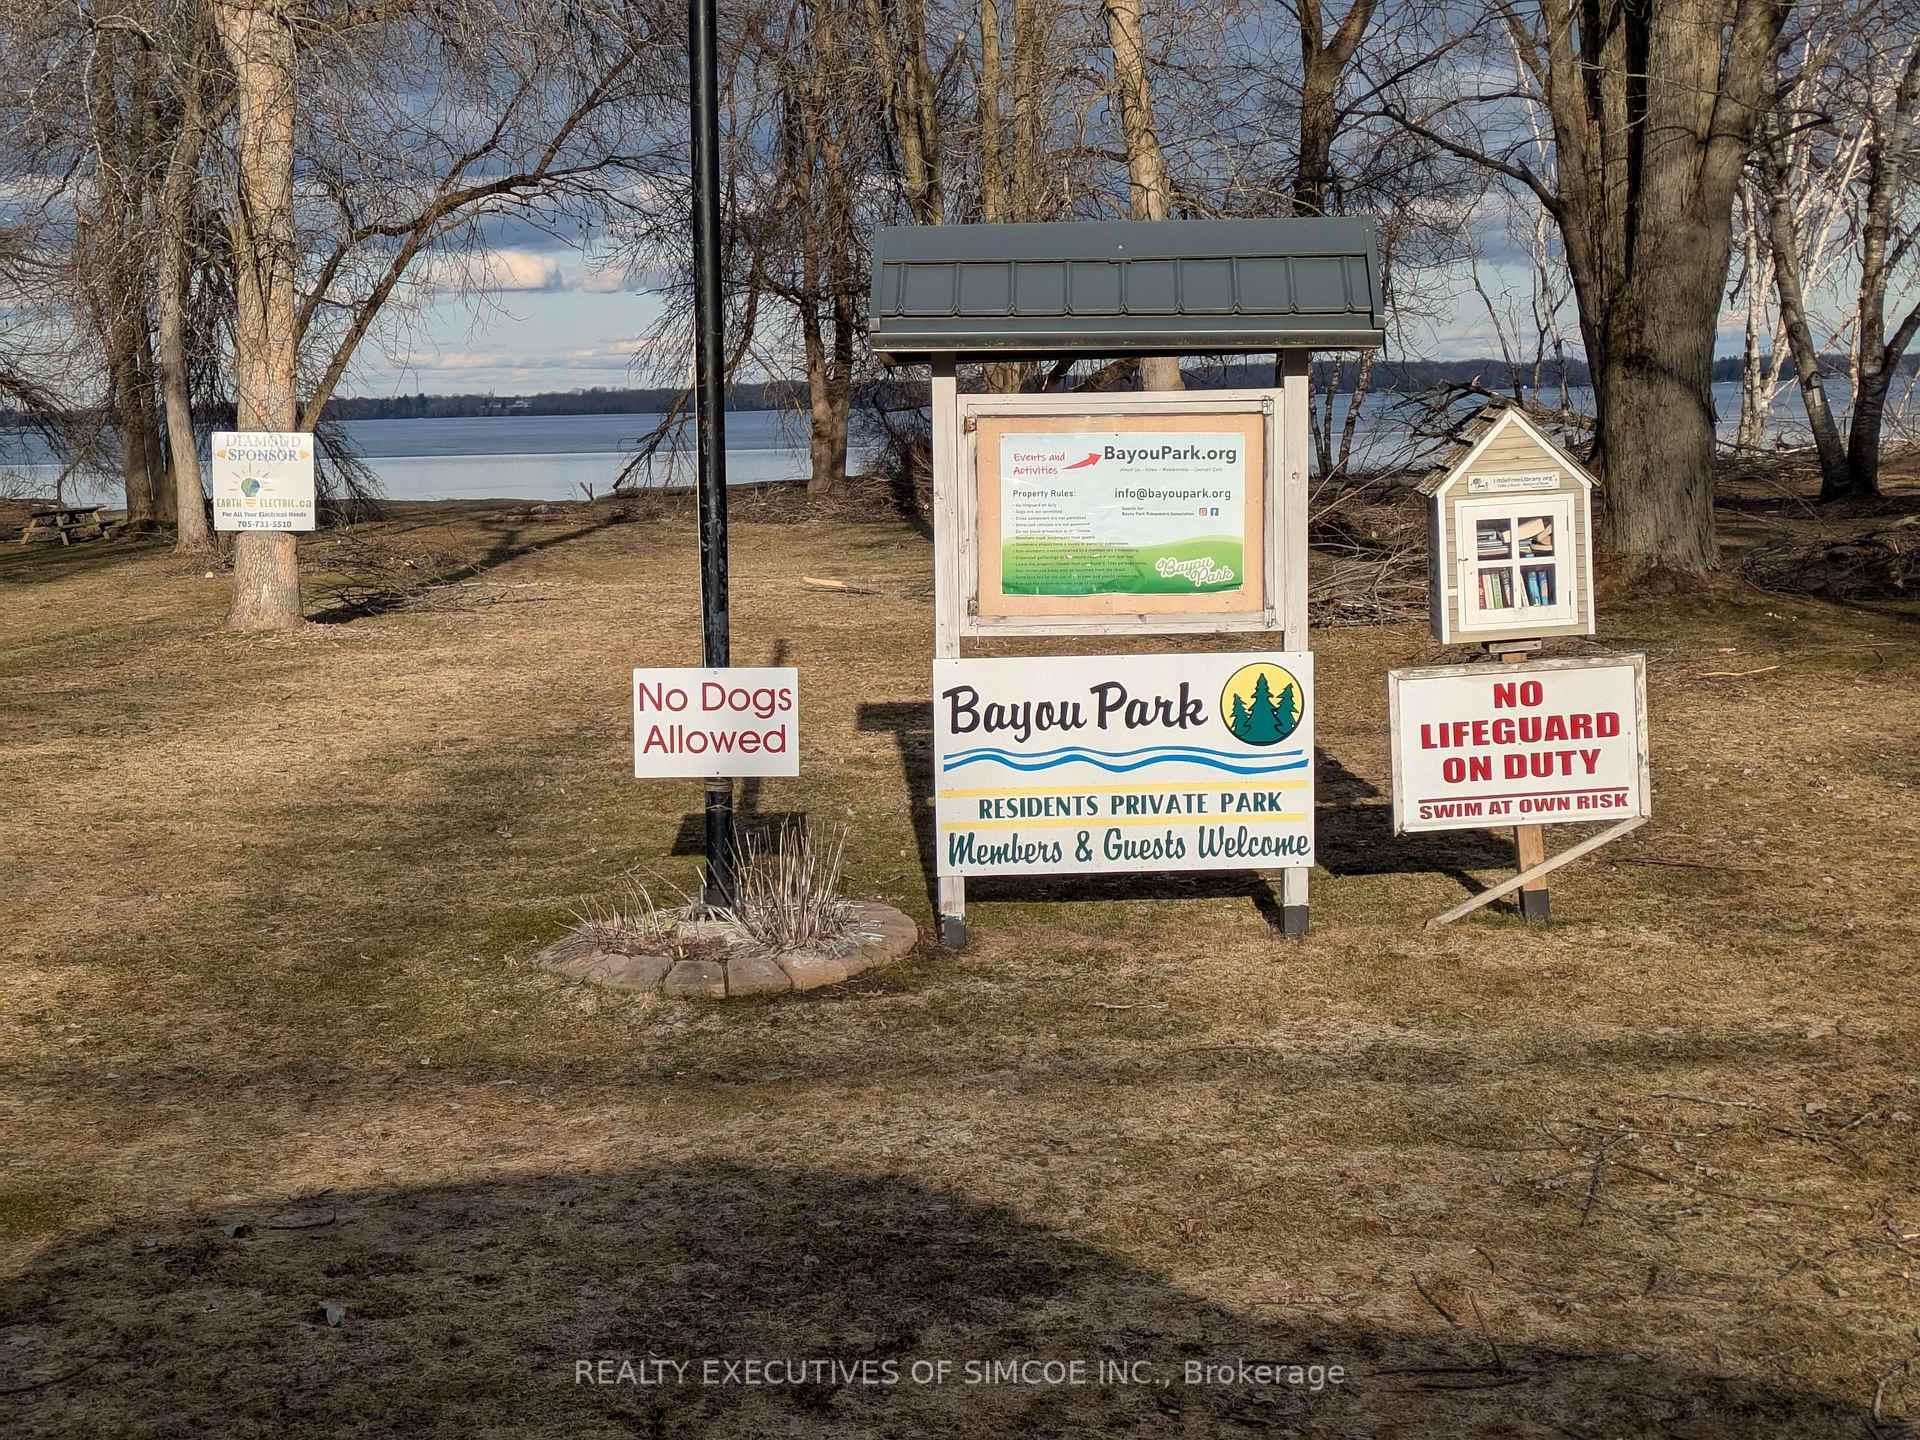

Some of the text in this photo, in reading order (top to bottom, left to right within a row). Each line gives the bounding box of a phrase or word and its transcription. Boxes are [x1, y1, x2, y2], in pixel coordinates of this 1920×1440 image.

[228, 448, 298, 461] SPONSOR
[1013, 452, 1066, 462] Events and
[1104, 445, 1237, 464] BayouPark.org
[1012, 465, 1058, 476] Activities
[216, 498, 242, 508] EARTH
[1013, 489, 1048, 499] Property
[1114, 488, 1232, 501] info@bayoupark.org
[1156, 556, 1214, 577] Bayou
[1189, 566, 1234, 587] Park
[639, 682, 792, 719] No Dogs
[1493, 680, 1544, 709] NO
[942, 681, 1209, 744] Bayou Park
[643, 724, 786, 754] Allowed
[1420, 711, 1620, 750] LIFEGUARD
[1442, 748, 1601, 784] ON DUTY
[978, 791, 1282, 820] RESIDENTS PRIVATE PARK
[1419, 793, 1629, 820] SWIM AT OWN RISK
[948, 826, 1311, 867] Members & Guests Welcome
